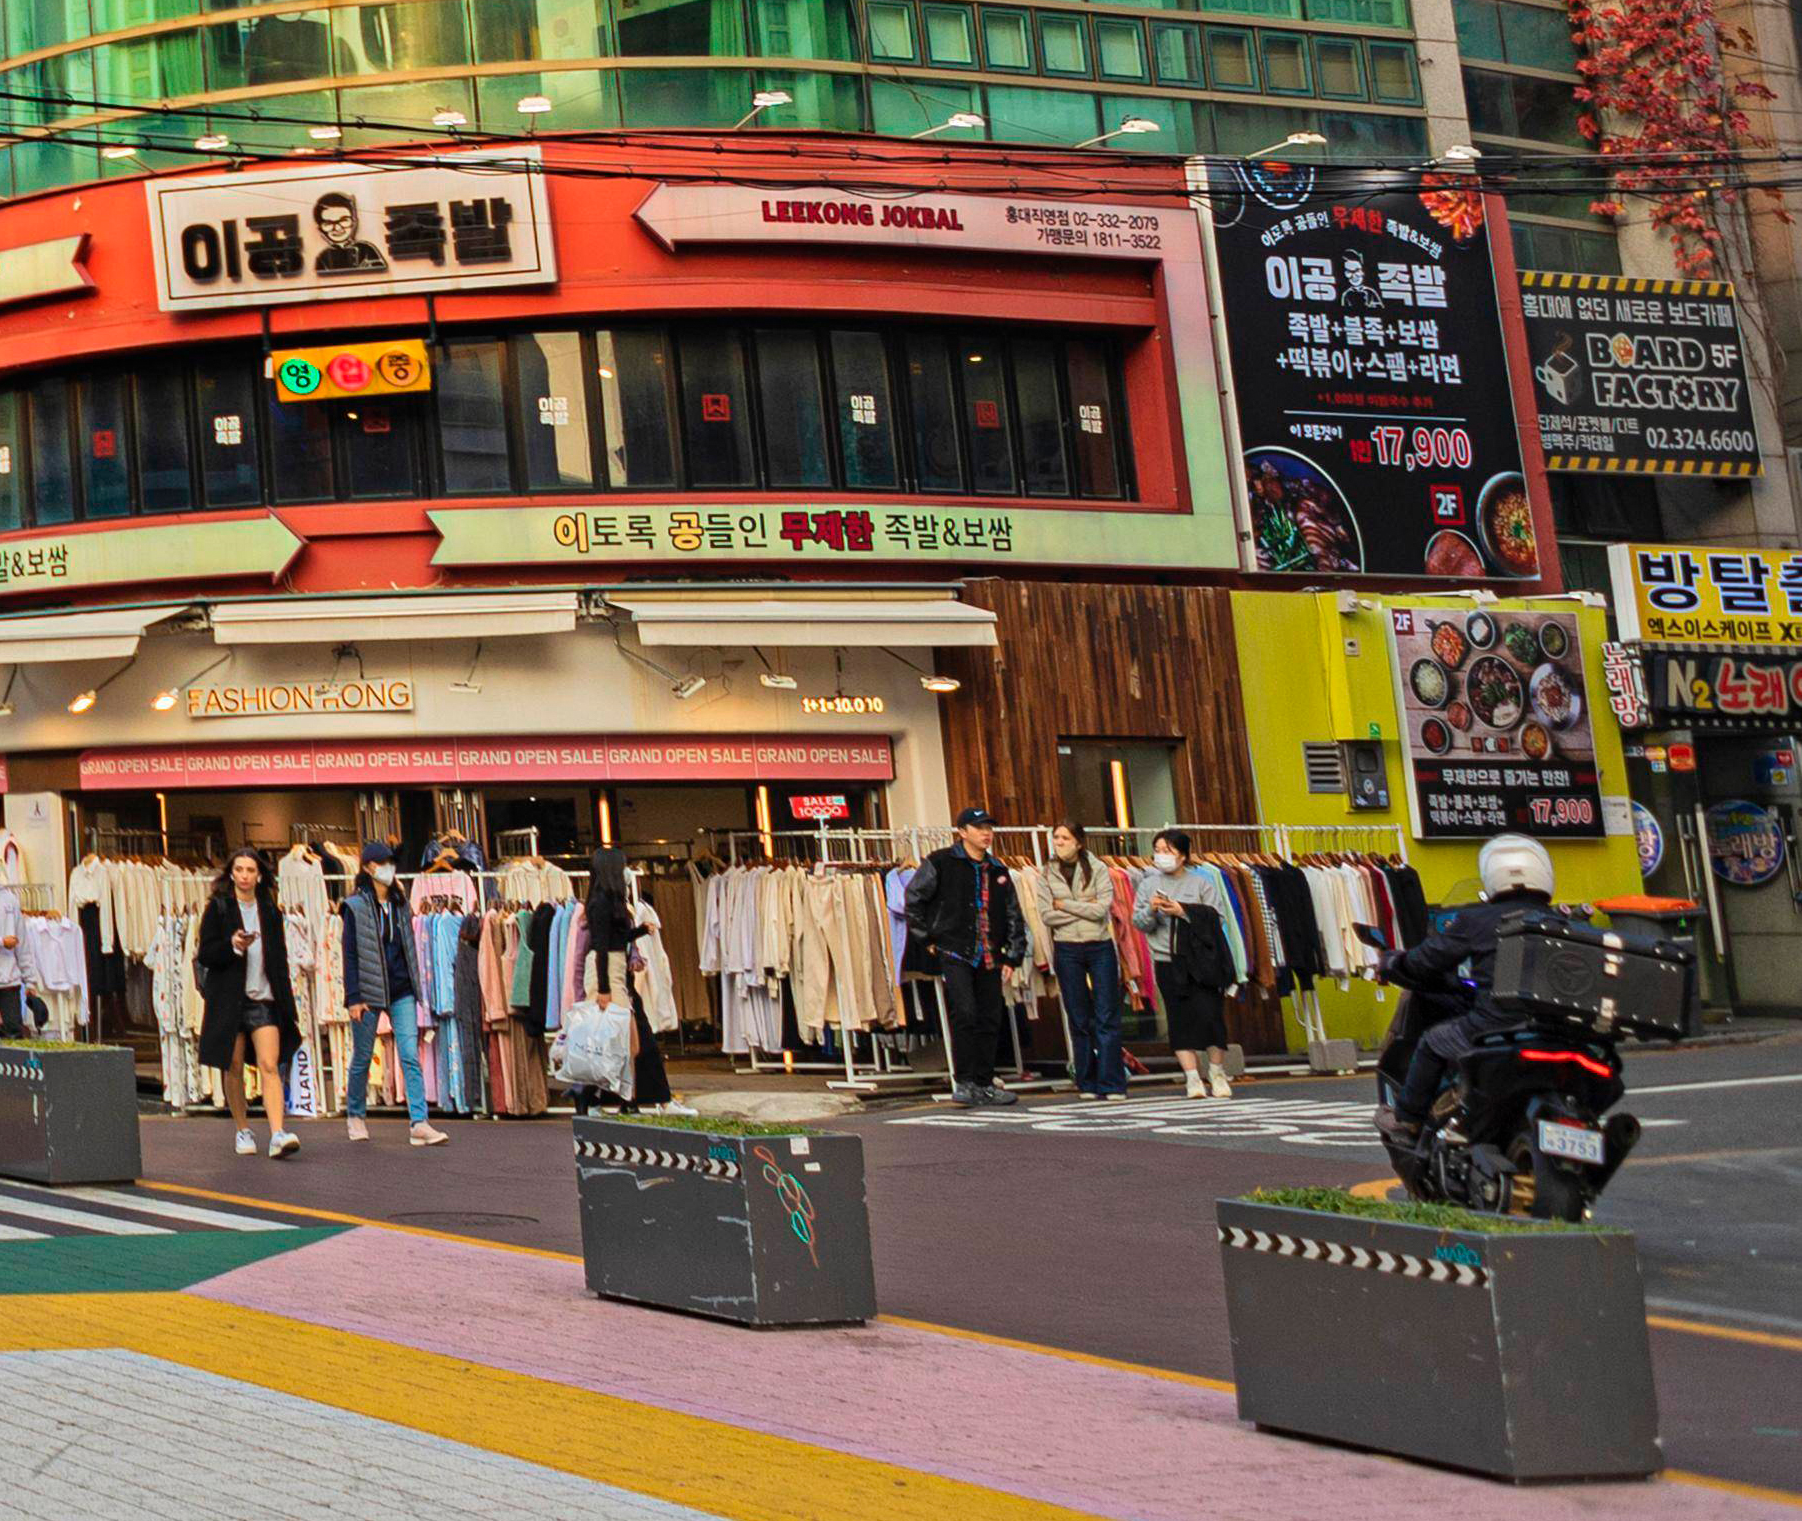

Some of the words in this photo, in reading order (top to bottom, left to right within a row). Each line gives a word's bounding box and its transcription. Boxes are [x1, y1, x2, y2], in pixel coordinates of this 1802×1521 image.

[761, 201, 874, 227] LEEKONG
[881, 206, 963, 231] JOKBAL
[1006, 207, 1069, 227] 홍대직영점
[1073, 211, 1159, 231] 02-332-2079
[1295, 211, 1330, 231] 공들인
[180, 215, 304, 286] 이공
[383, 196, 514, 265] 족발
[1036, 227, 1088, 247] 가맹문의
[1093, 232, 1162, 251] 1811-3522
[1265, 255, 1337, 302] 이공
[1377, 262, 1448, 308] 족발
[1522, 294, 1573, 320] 홍대에
[1576, 296, 1611, 322] 없던
[1616, 299, 1664, 325] 새로운
[1668, 301, 1735, 328] 보드카페
[1288, 312, 1440, 350] 족발+불족+보쌈
[1710, 344, 1738, 368] 5F
[286, 351, 417, 391] 영업중
[1592, 372, 1739, 412] FACTORY
[1370, 427, 1472, 472] 17,900
[1647, 427, 1755, 452] 02.324.6600
[1434, 491, 1459, 518] 2F
[553, 512, 657, 554] 이토록
[668, 511, 768, 550] 공들인
[779, 510, 875, 552] 무제한
[884, 514, 1013, 553] 족발&보쌈
[1394, 611, 1412, 633] 2F
[1648, 618, 1773, 642] 엑스이스케이프
[1601, 641, 1640, 726] 노래방
[1666, 658, 1714, 710] N2
[187, 685, 314, 716] FASHION
[80, 758, 115, 776] GRAND
[118, 757, 149, 775] OPEN
[151, 756, 184, 773] SALE
[187, 755, 230, 773] GRAND
[233, 754, 271, 771] OPEN
[274, 753, 311, 770] SALE
[315, 752, 359, 770] GRAND
[362, 751, 403, 768] OPEN
[407, 751, 453, 768] SALE
[459, 750, 511, 766] GRAND
[514, 749, 557, 766] OPEN
[560, 749, 605, 766] SALE
[608, 748, 657, 765] GRAND
[660, 748, 706, 764] OPEN
[709, 748, 752, 764] SALE
[756, 748, 806, 764] GRAND
[810, 748, 848, 763] OPEN
[851, 748, 888, 764] SALE
[1442, 769, 1501, 786] 무제한으로
[1504, 770, 1540, 787] 즐기는
[802, 796, 833, 806] SALE
[1529, 798, 1594, 827] 17,900
